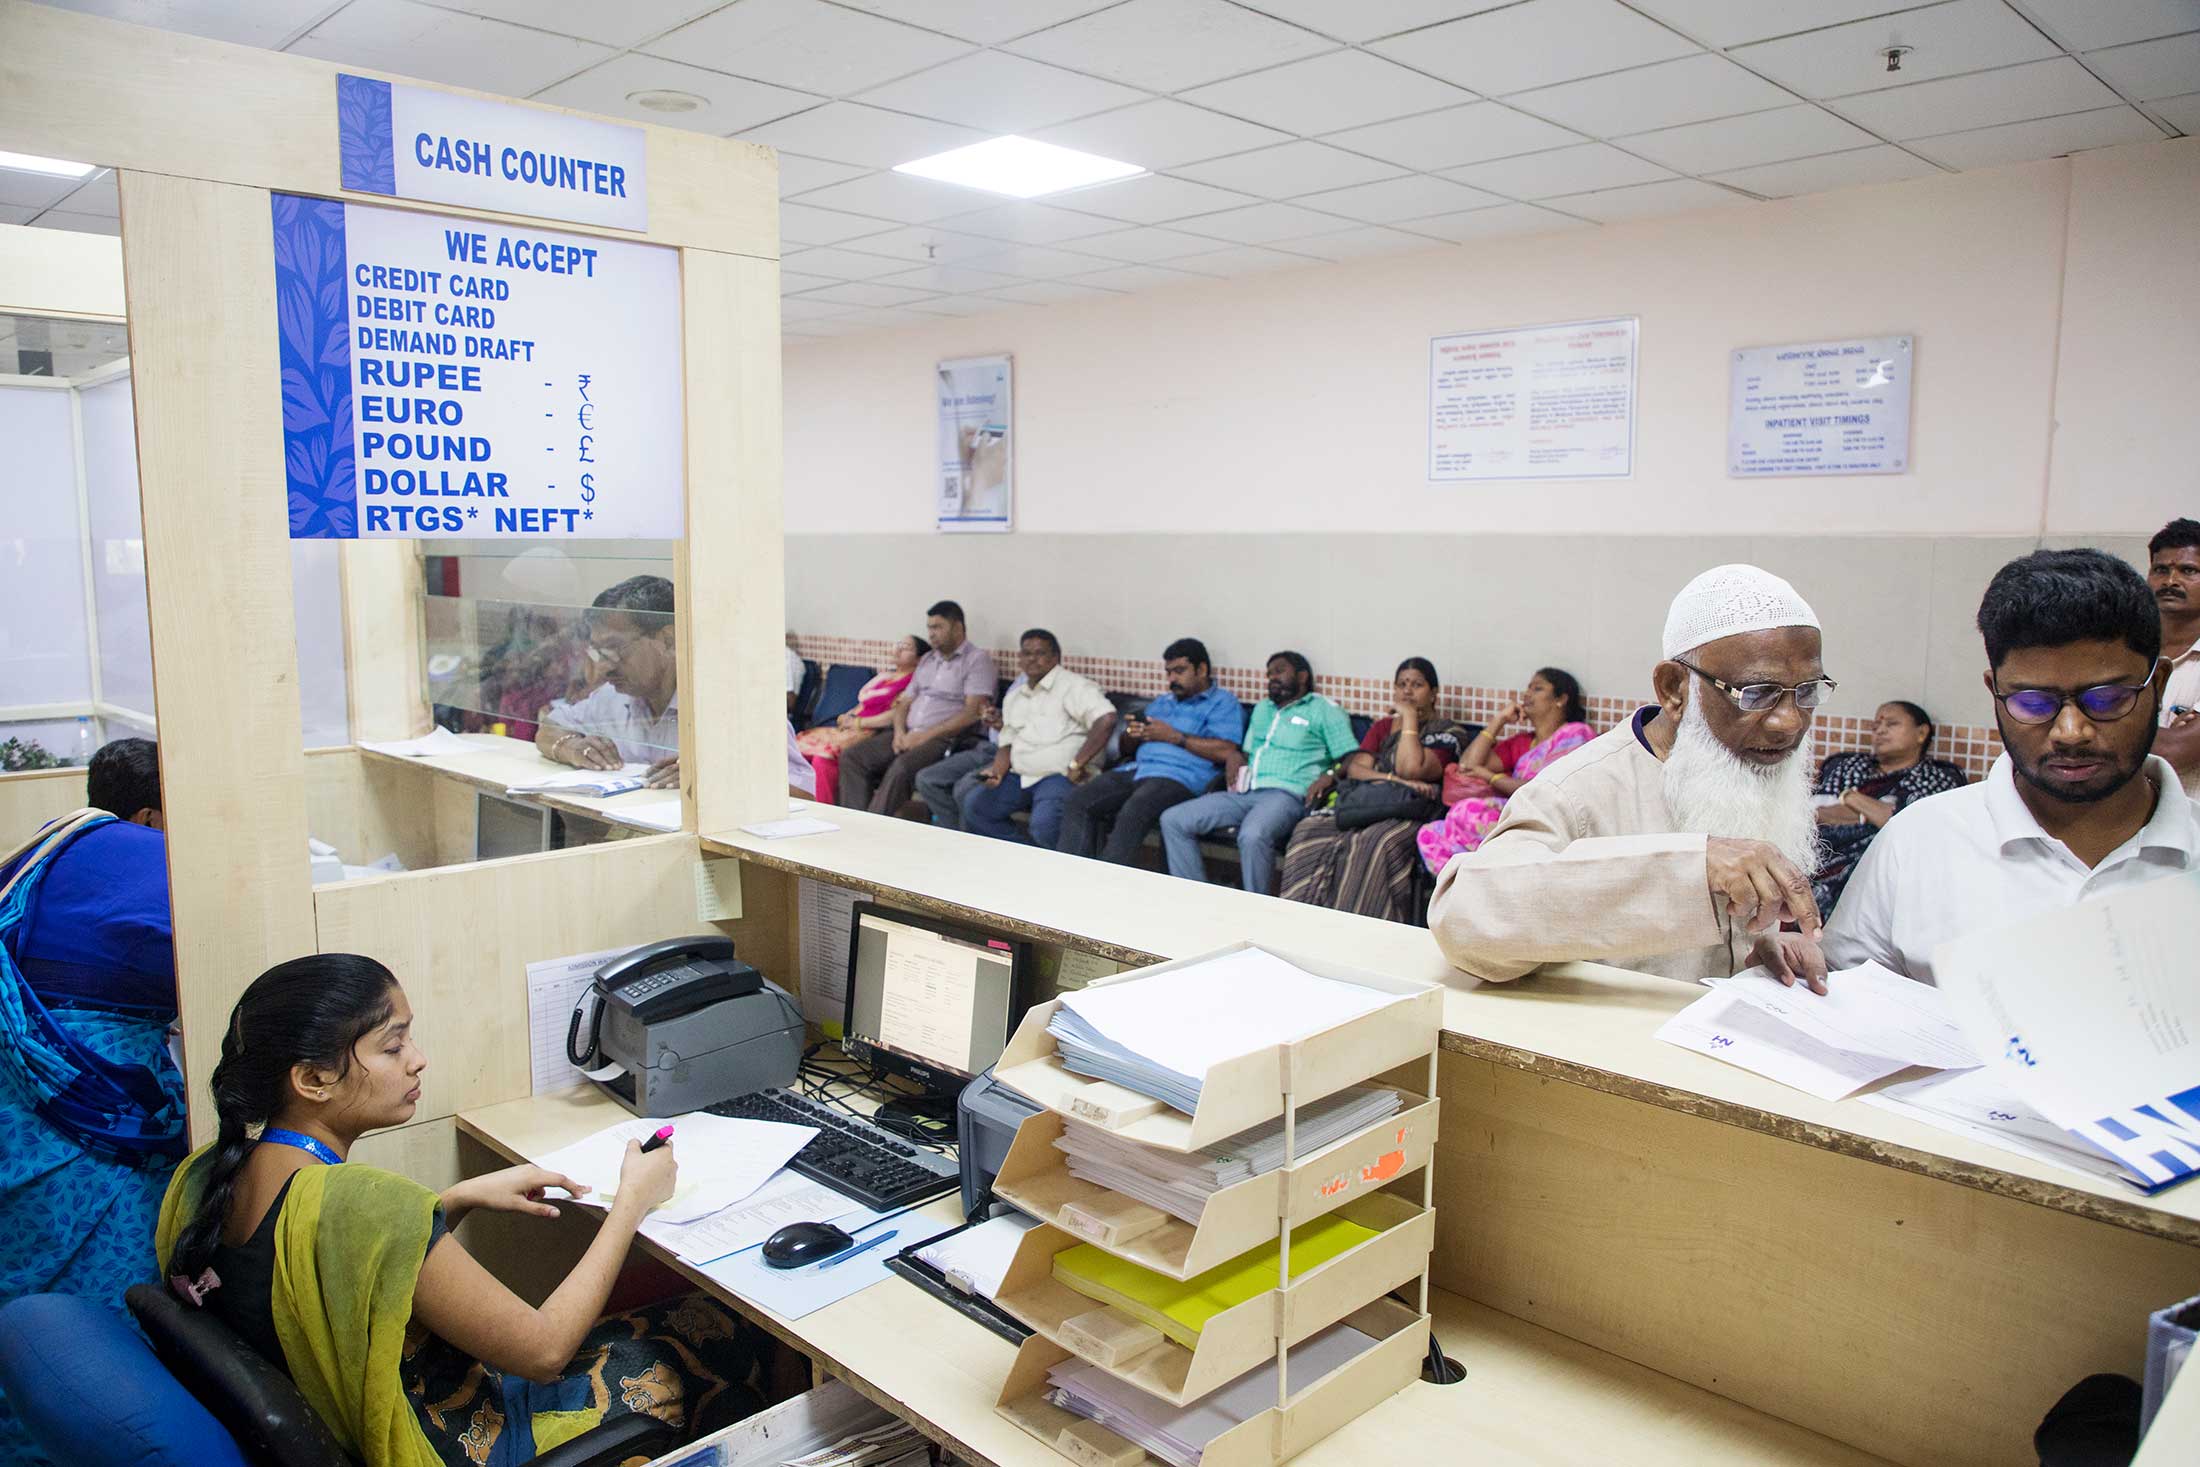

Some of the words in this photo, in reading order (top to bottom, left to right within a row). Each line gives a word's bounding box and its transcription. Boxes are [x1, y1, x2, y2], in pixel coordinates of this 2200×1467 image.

[415, 132, 492, 177] CASH
[500, 146, 626, 199] COUNTER
[445, 229, 487, 264] WE
[495, 237, 598, 278] ACCEPT
[354, 263, 442, 295] CREDIT
[449, 273, 510, 302] CARD
[356, 294, 427, 324] DEBIT
[434, 303, 495, 330] CARD
[357, 326, 457, 356] DEMAND
[464, 335, 535, 362] DRAFT
[359, 357, 482, 392] RUPEE
[577, 374, 592, 402] ₹
[361, 395, 463, 427] EURO
[577, 403, 594, 431] €
[1764, 417, 1807, 429] INPATIENT
[1809, 415, 1832, 426] VISIT
[1833, 413, 1871, 425] TIMINGS
[362, 431, 492, 463] POUND
[578, 434, 595, 463] £
[364, 468, 510, 498] DOLLAR
[580, 472, 596, 505] $
